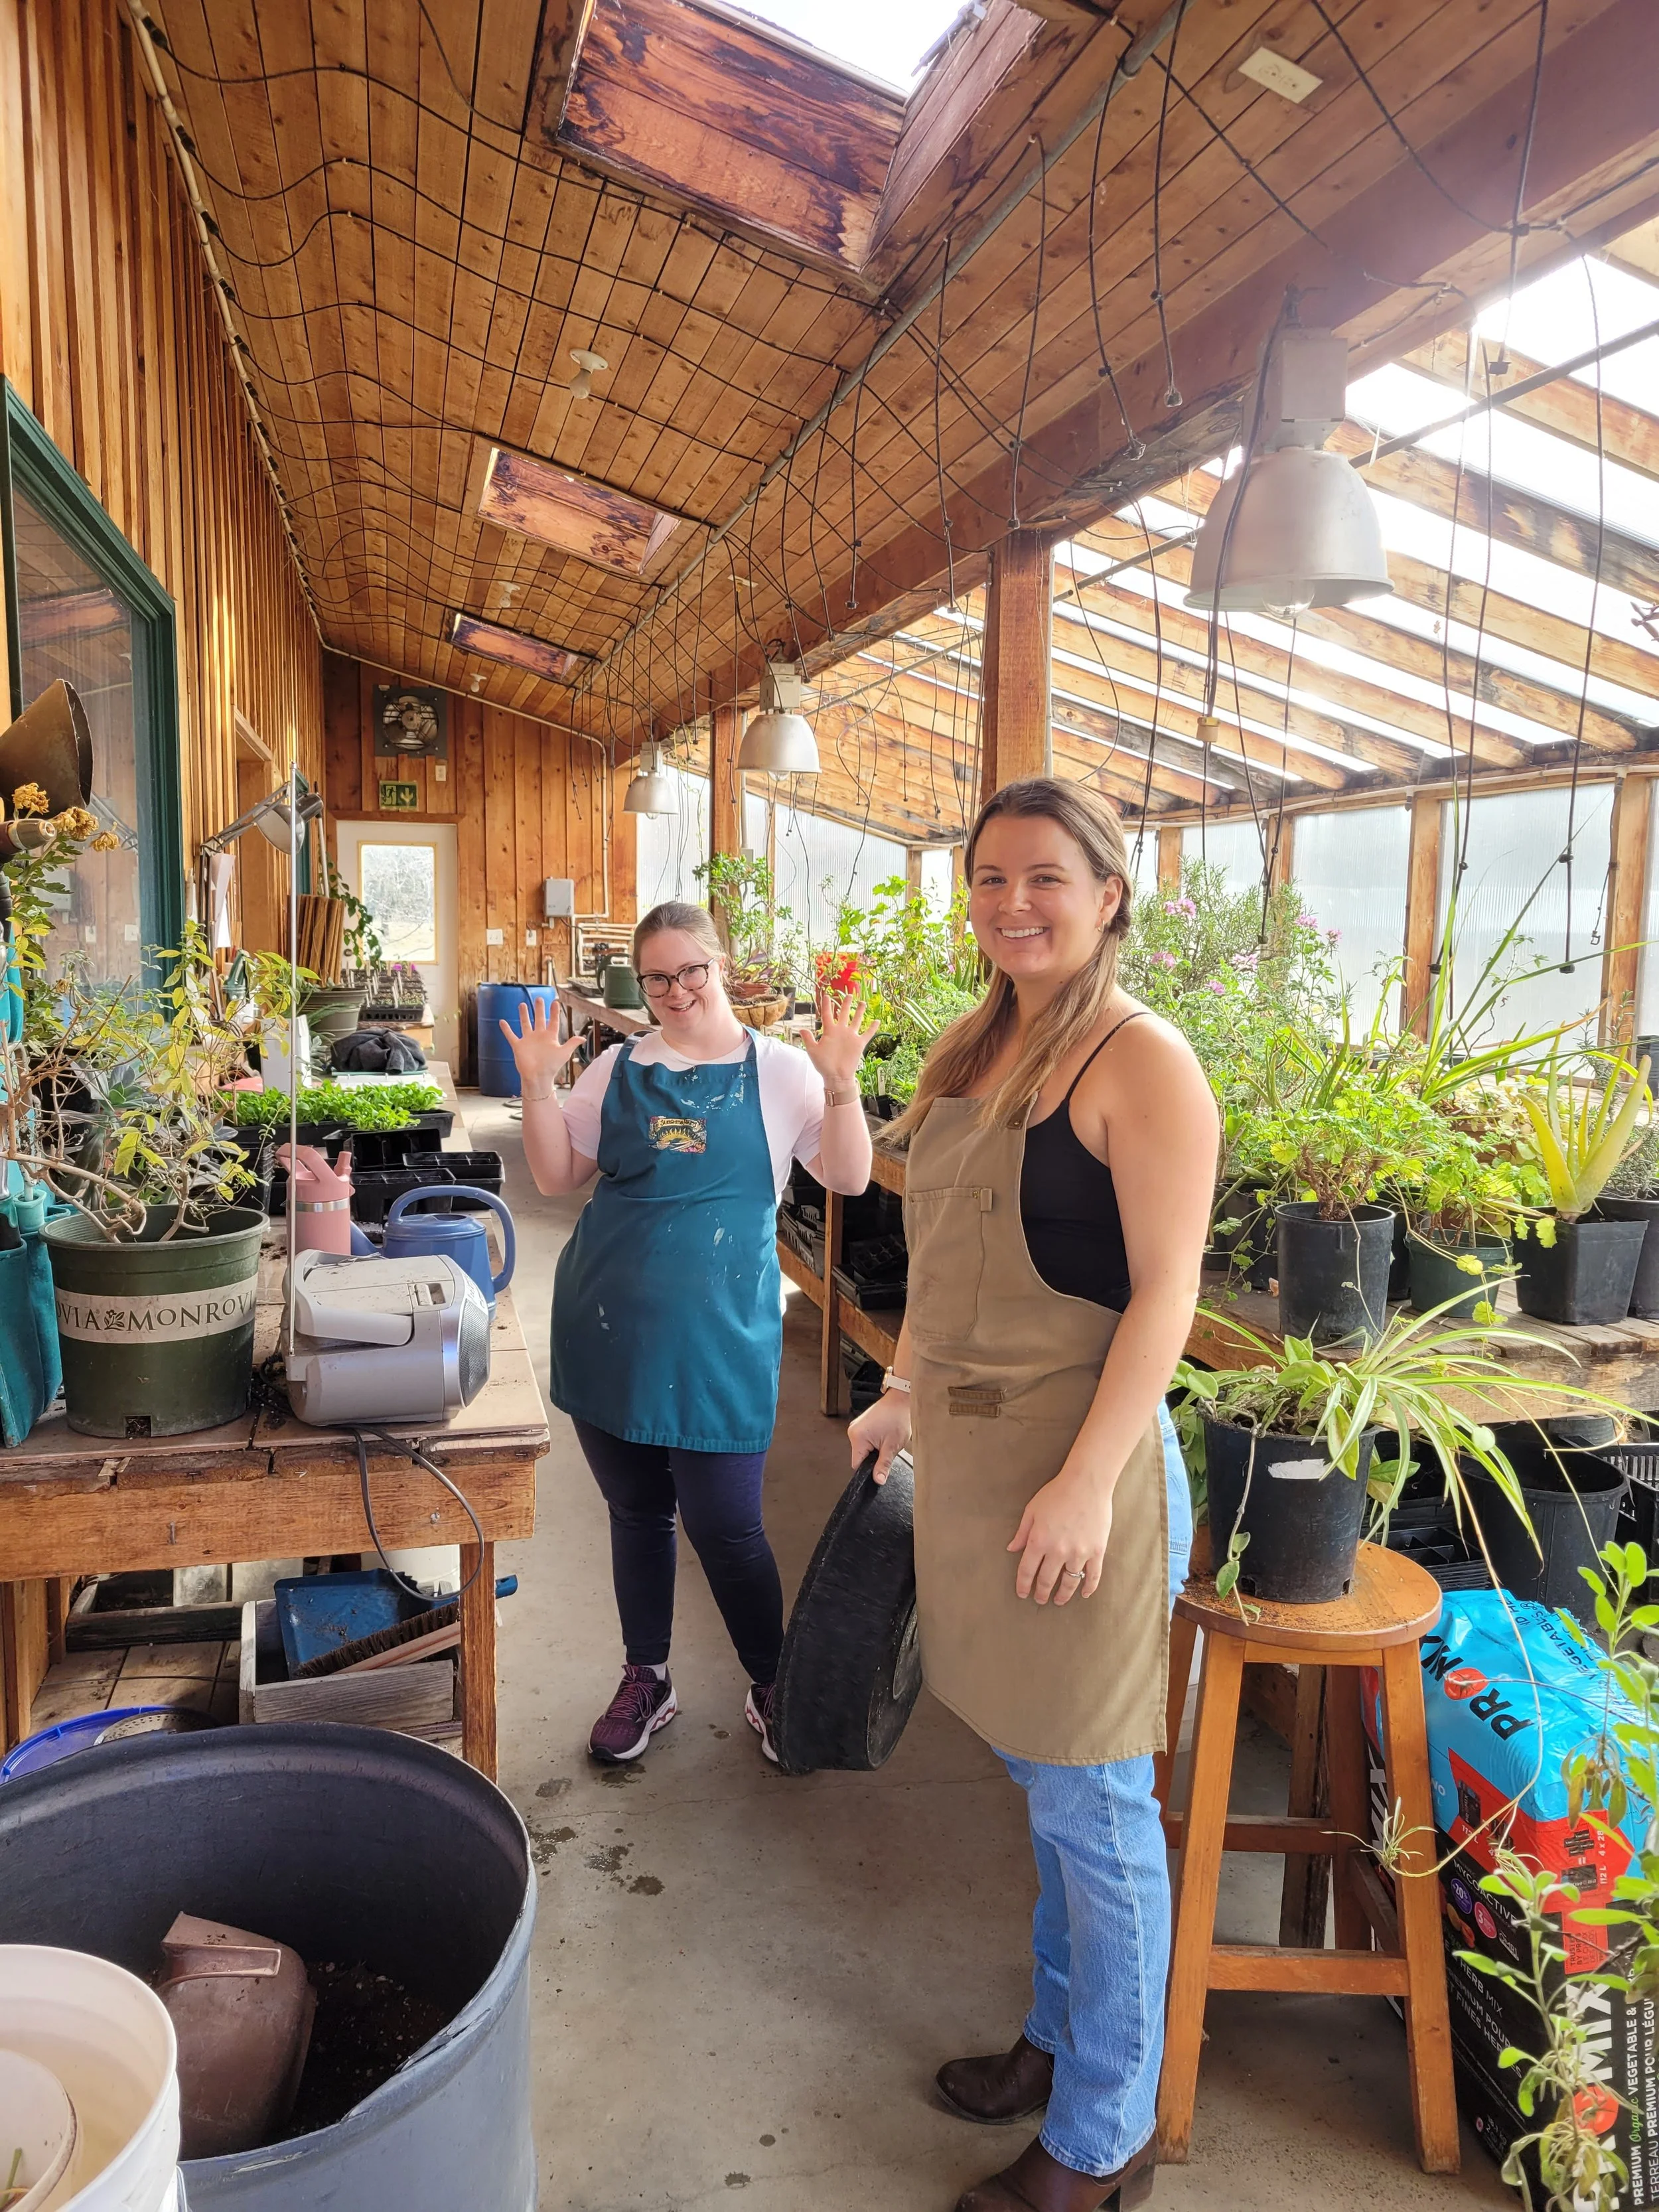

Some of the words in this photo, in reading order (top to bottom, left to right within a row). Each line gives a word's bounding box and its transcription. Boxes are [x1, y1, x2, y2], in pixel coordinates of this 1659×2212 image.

[1486, 1990, 1503, 2019] MIX
[1626, 2006, 1636, 2016] &
[1642, 1998, 1656, 2036] LÉGU
[1456, 1991, 1481, 2029] FINES
[1483, 2026, 1522, 2079] HERS
[1626, 2018, 1638, 2096] VEGETABLE
[1645, 2077, 1658, 2138] PREMIUM
[1630, 2145, 1644, 2205] PREMIUM
